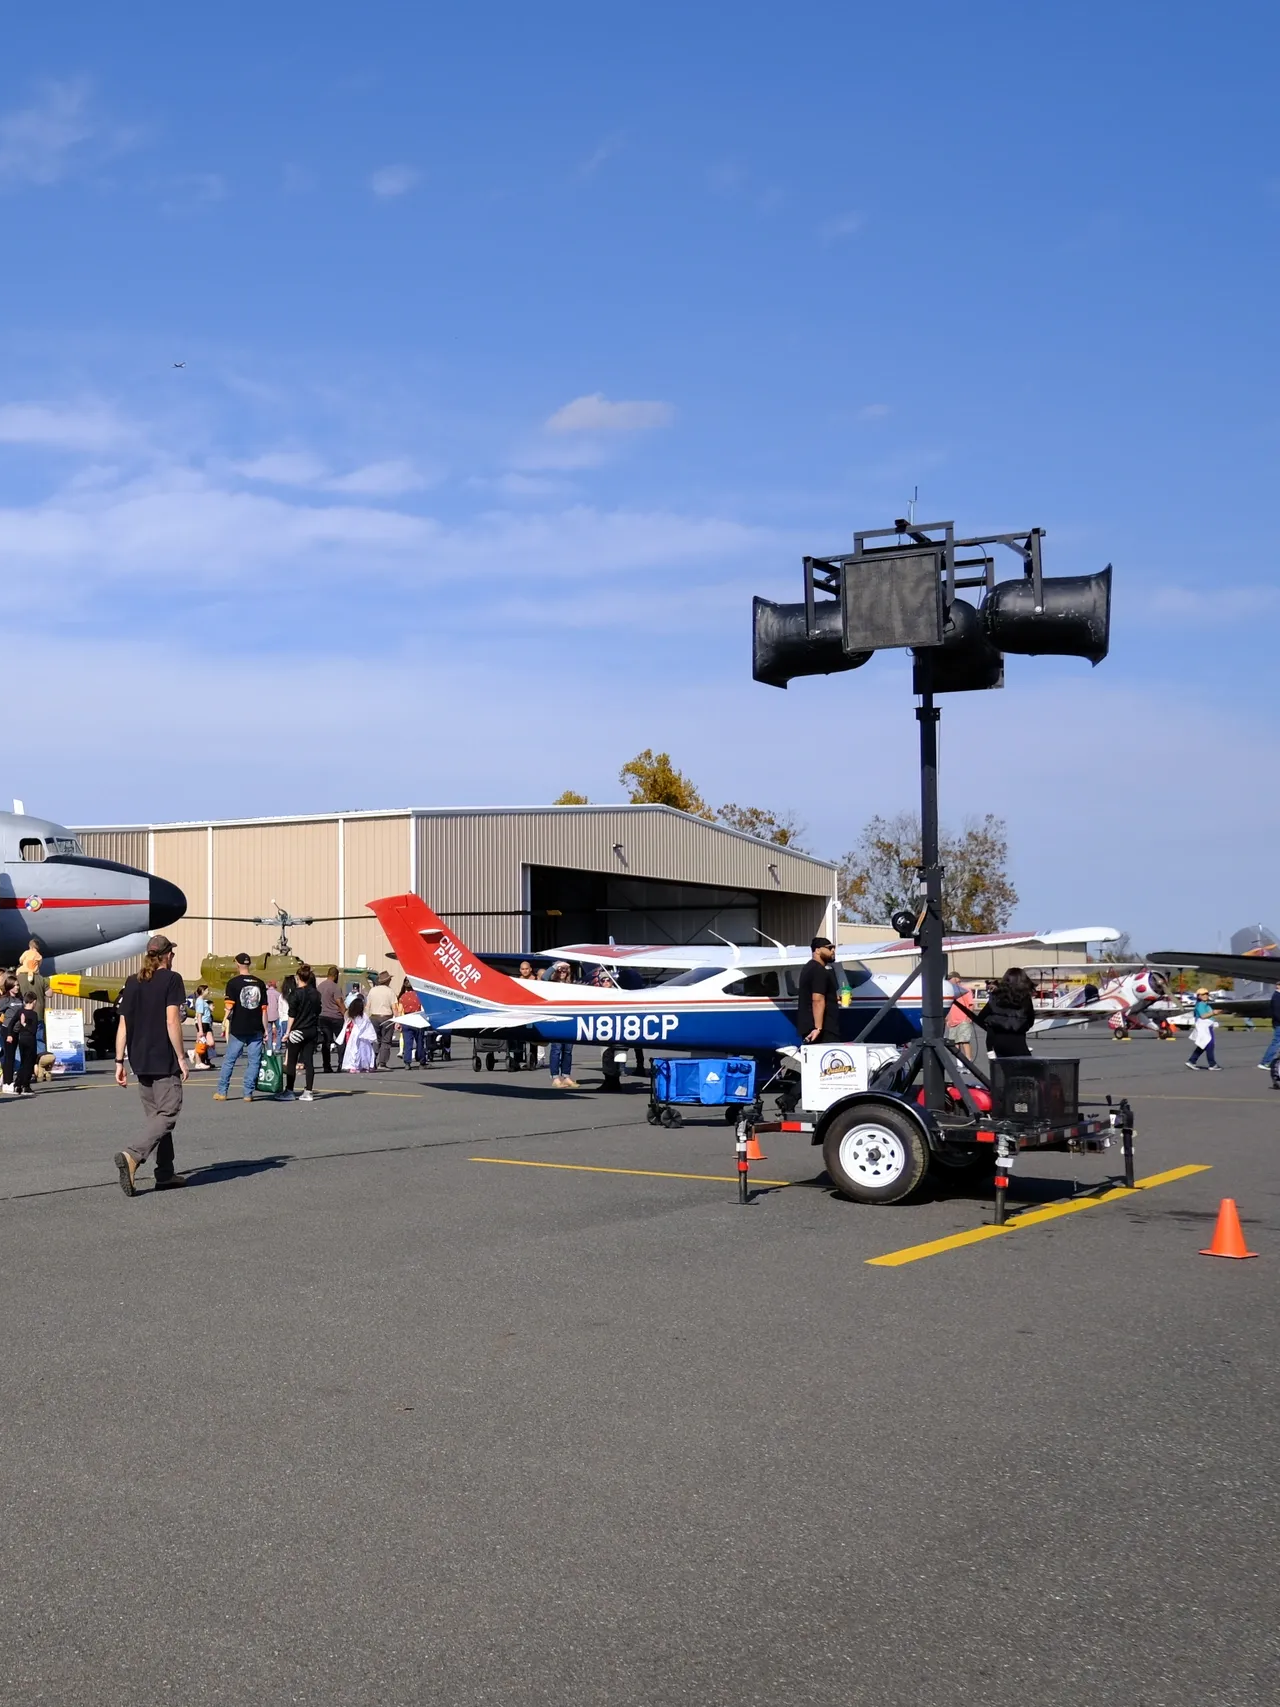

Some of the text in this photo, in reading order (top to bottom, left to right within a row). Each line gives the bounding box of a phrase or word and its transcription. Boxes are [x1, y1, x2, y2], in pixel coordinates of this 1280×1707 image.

[433, 946, 470, 990] PATROL
[439, 935, 482, 984] CIVIL AIR
[576, 1014, 679, 1041] N818CP
